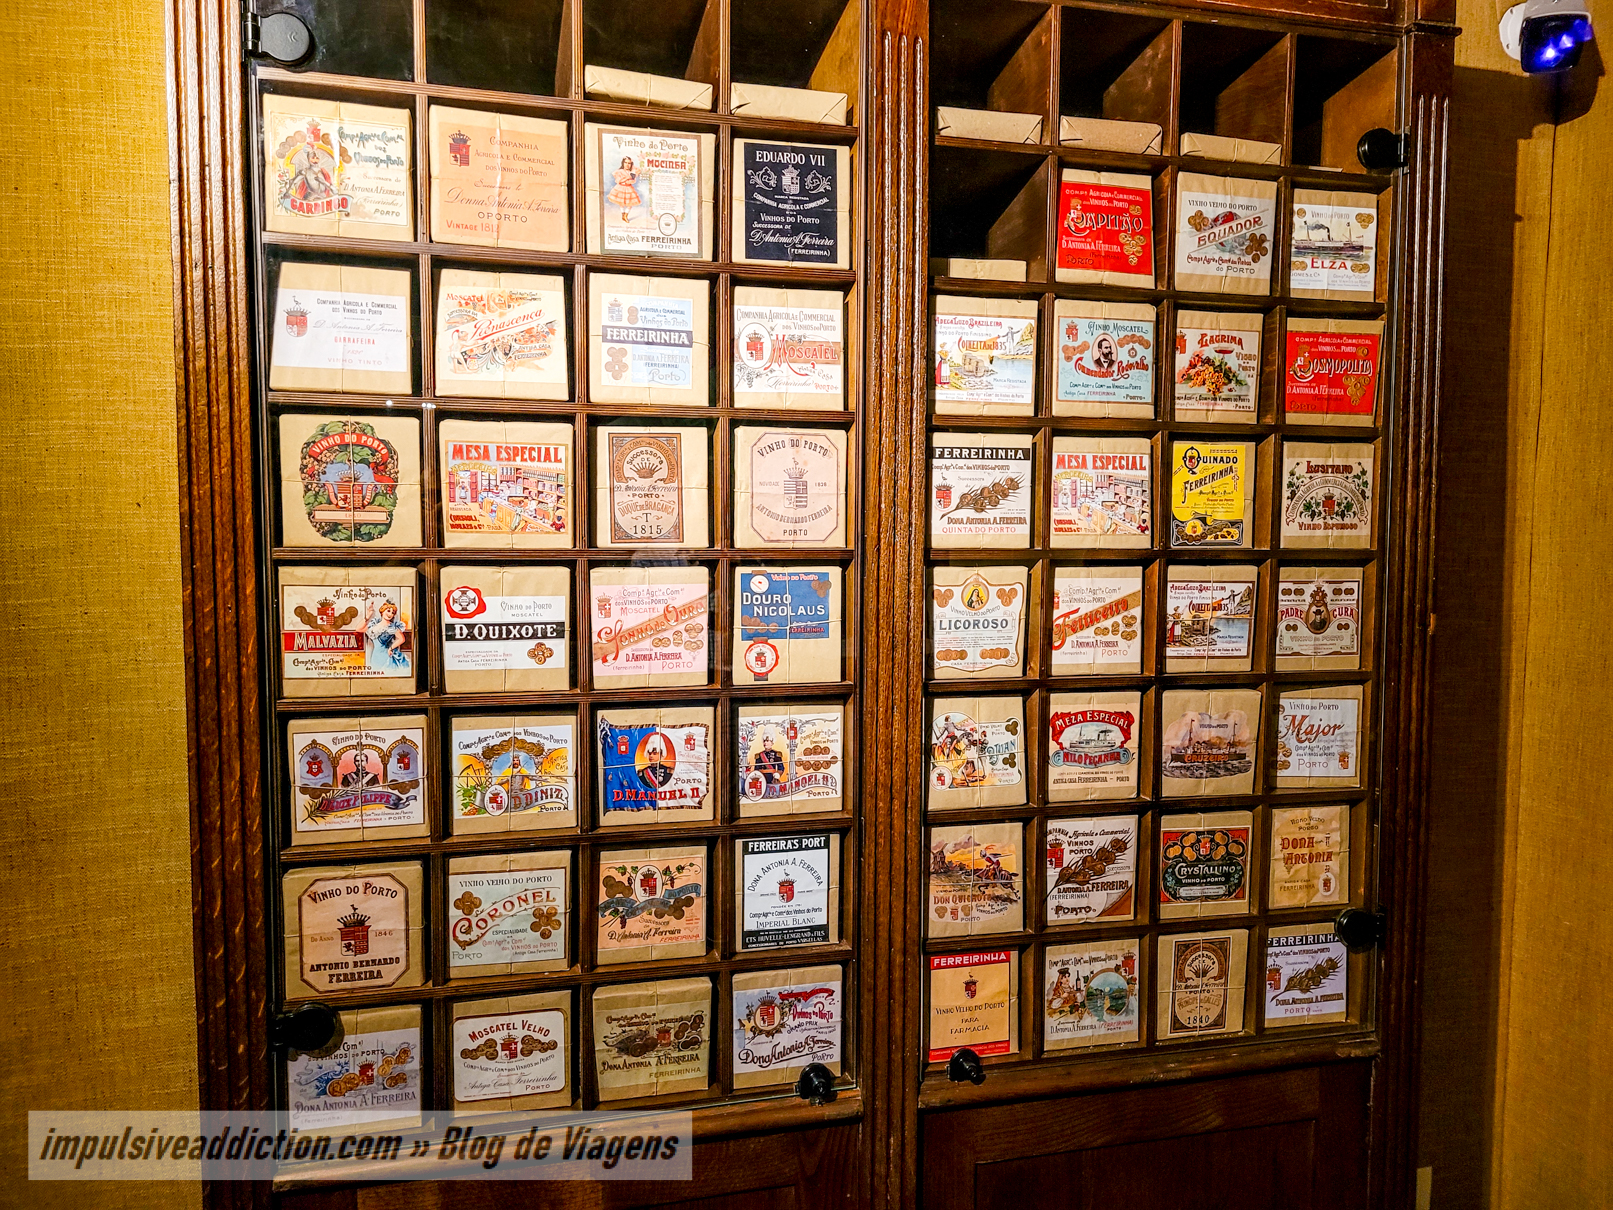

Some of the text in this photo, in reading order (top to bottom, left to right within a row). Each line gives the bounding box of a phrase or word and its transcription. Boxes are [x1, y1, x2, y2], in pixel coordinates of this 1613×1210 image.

[490, 136, 539, 150] COMPANHIA
[660, 140, 688, 152] Porto
[513, 153, 555, 166] COMMERCIAL
[755, 150, 825, 166] EDUARDO VII
[374, 208, 400, 217] PORTO
[478, 211, 528, 223] OPORTO
[760, 213, 785, 222] VINHOS
[797, 215, 820, 225] PORTO
[446, 220, 478, 232] VINTAGE
[1197, 215, 1264, 247] EQUADOR
[641, 235, 692, 245] FERREIRINHA
[787, 247, 830, 257] (FERREIRINHA)
[1226, 265, 1255, 274] PORTO
[1311, 258, 1349, 270] ELZA
[446, 293, 484, 302] MOSCATEL
[368, 308, 382, 316] PORTO
[371, 302, 398, 310] COMMERCIAL
[769, 310, 795, 322] AGRICOLA
[799, 310, 835, 322] COMMERCIAL
[793, 323, 813, 331] VINHOS
[1111, 323, 1149, 334] MOSCATEL
[334, 336, 376, 345] GARRAFEIRA
[606, 327, 690, 344] FERREIRINHA
[312, 434, 388, 456] VINHO DO PORTO
[757, 439, 829, 457] VINHO DO PORTO
[452, 444, 562, 463] MESA ESPECIAL
[935, 449, 1024, 459] FERREIRINHA
[1056, 455, 1146, 470] MESA ESPECIAL
[1182, 465, 1234, 504] FERREIRINHA
[642, 513, 651, 522] T
[807, 504, 833, 522] FERREIRA
[632, 525, 662, 535] 1815
[1298, 522, 1321, 530] VINHO
[742, 592, 792, 605] DOURO
[533, 601, 552, 612] PORTO
[620, 607, 663, 615] MOSCATEL
[753, 605, 826, 617] NICOLAUS
[1280, 607, 1354, 620] PADRE CURA
[939, 618, 1008, 630] LICOROSO
[294, 633, 358, 651] MALVAZIA
[1102, 649, 1128, 657] PORTO
[662, 660, 693, 671] PORTO
[1318, 702, 1339, 710] PORTO
[1055, 711, 1128, 730] MEZA ESPECIAL
[1279, 715, 1345, 744] Major
[1062, 751, 1121, 765] NILO PEÇANHA
[1185, 753, 1229, 762] CRUZEIRO
[1297, 758, 1328, 768] PORTO
[674, 777, 702, 785] PORTO
[749, 837, 826, 852] FERREIRA'S PORT
[749, 859, 823, 892] DONA ANTONIA FERREIRA
[1174, 863, 1236, 878] CRYSTALLINO
[526, 876, 553, 884] PORTO
[1091, 880, 1128, 892] FERREIRA
[308, 882, 398, 904] VINHO DO PORTO
[934, 894, 950, 905] DON
[1054, 905, 1092, 915] PORTO
[452, 890, 557, 950] CORONEL
[756, 916, 816, 929] IMPERIAL BLANC
[452, 951, 483, 960] PORTO
[934, 952, 1006, 967] FERREIRINHA
[310, 957, 400, 972] ANTONIO BERNARDO
[328, 970, 384, 984] FERREIRA
[935, 1001, 1004, 1015] VINHO PORTO
[1187, 1015, 1210, 1024] 1840
[468, 1020, 550, 1042] MOSCATEL VELHO
[950, 1024, 990, 1034] FARMACIA
[811, 1053, 834, 1062] PORTO
[649, 1067, 701, 1079] FERREIRINHA
[525, 1083, 551, 1091] PORTO
